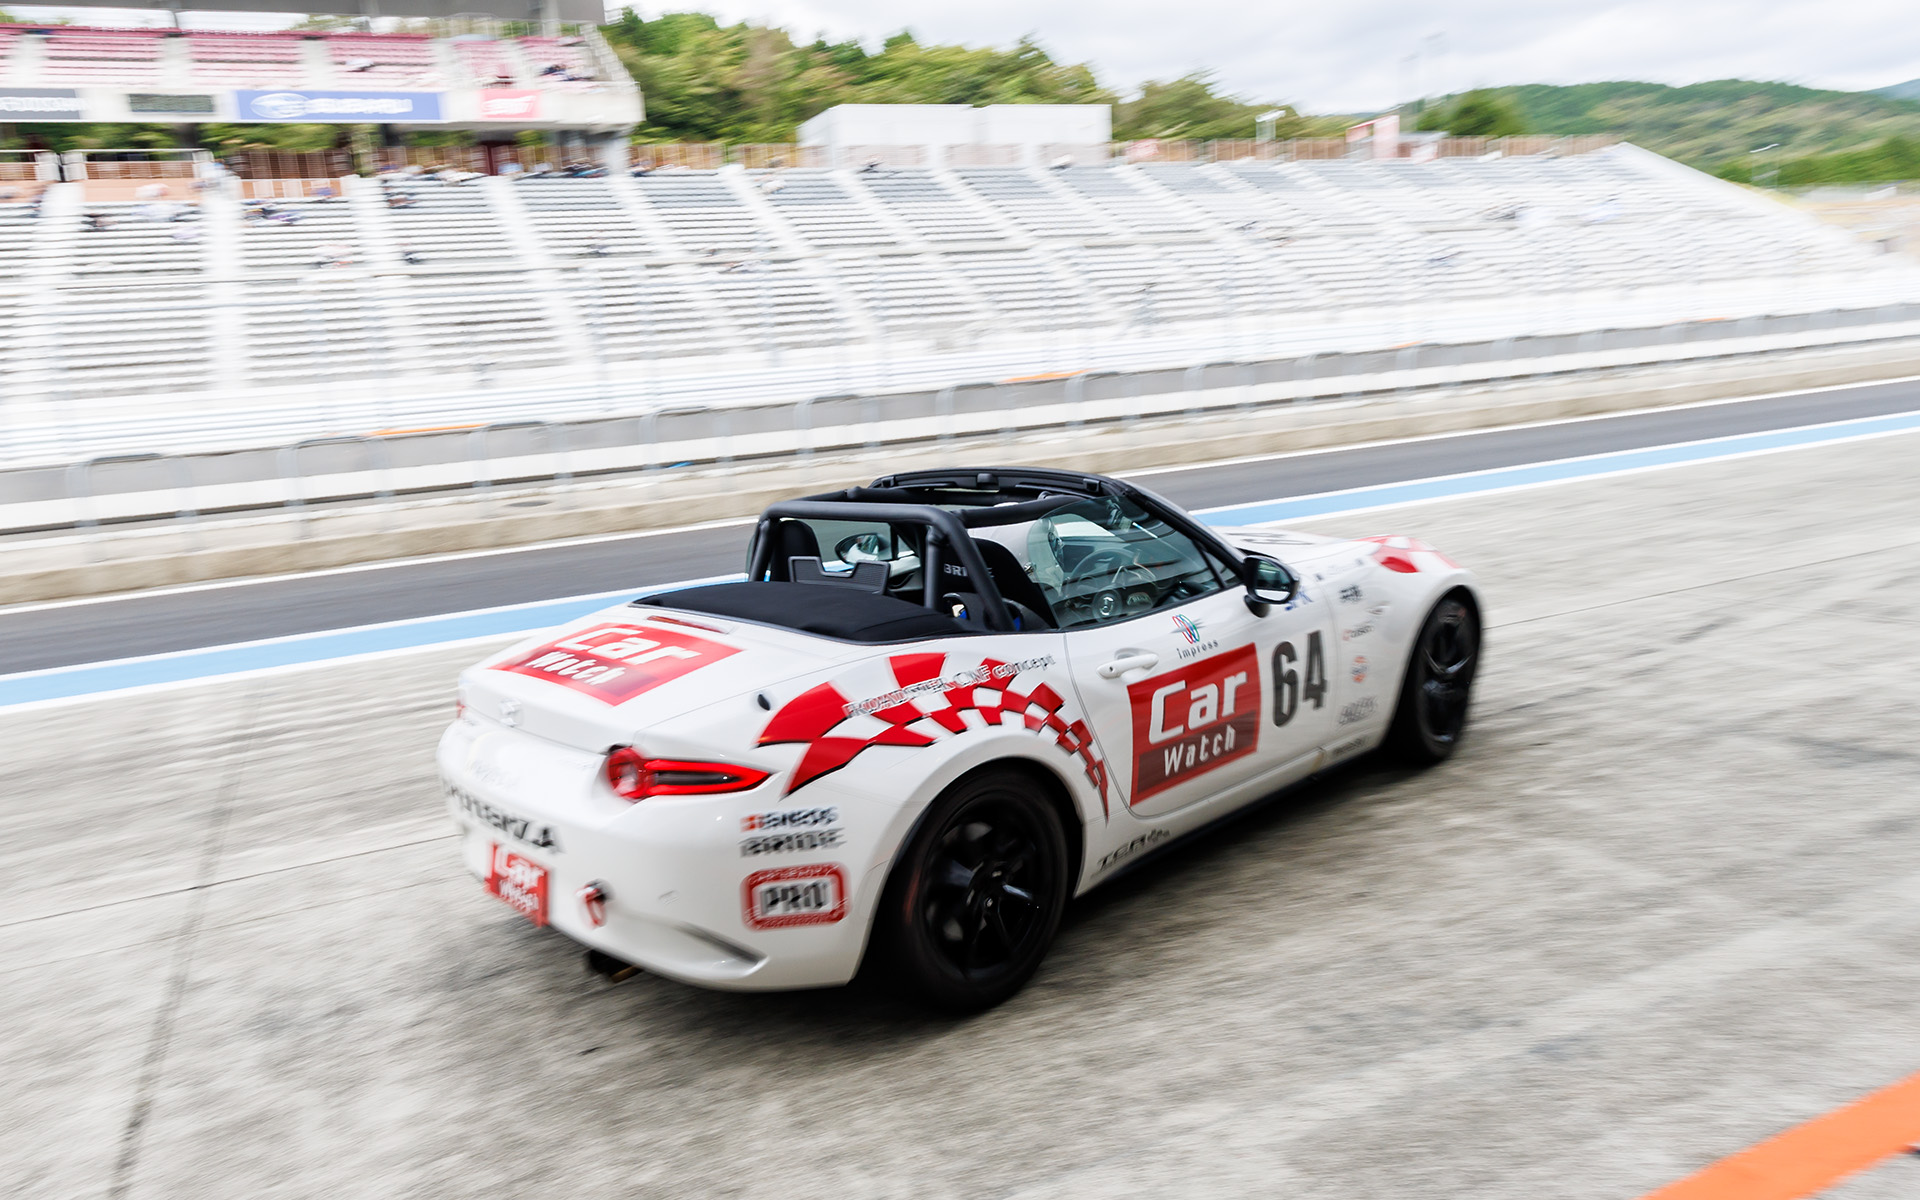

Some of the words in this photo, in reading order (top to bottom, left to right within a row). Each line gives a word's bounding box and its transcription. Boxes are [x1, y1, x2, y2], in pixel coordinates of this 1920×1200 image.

[525, 650, 627, 686] Watch
[555, 628, 702, 666] Car
[992, 654, 1056, 680] concept
[1271, 630, 1327, 728] 64
[1149, 671, 1248, 745] Car
[1164, 724, 1236, 777] Watch
